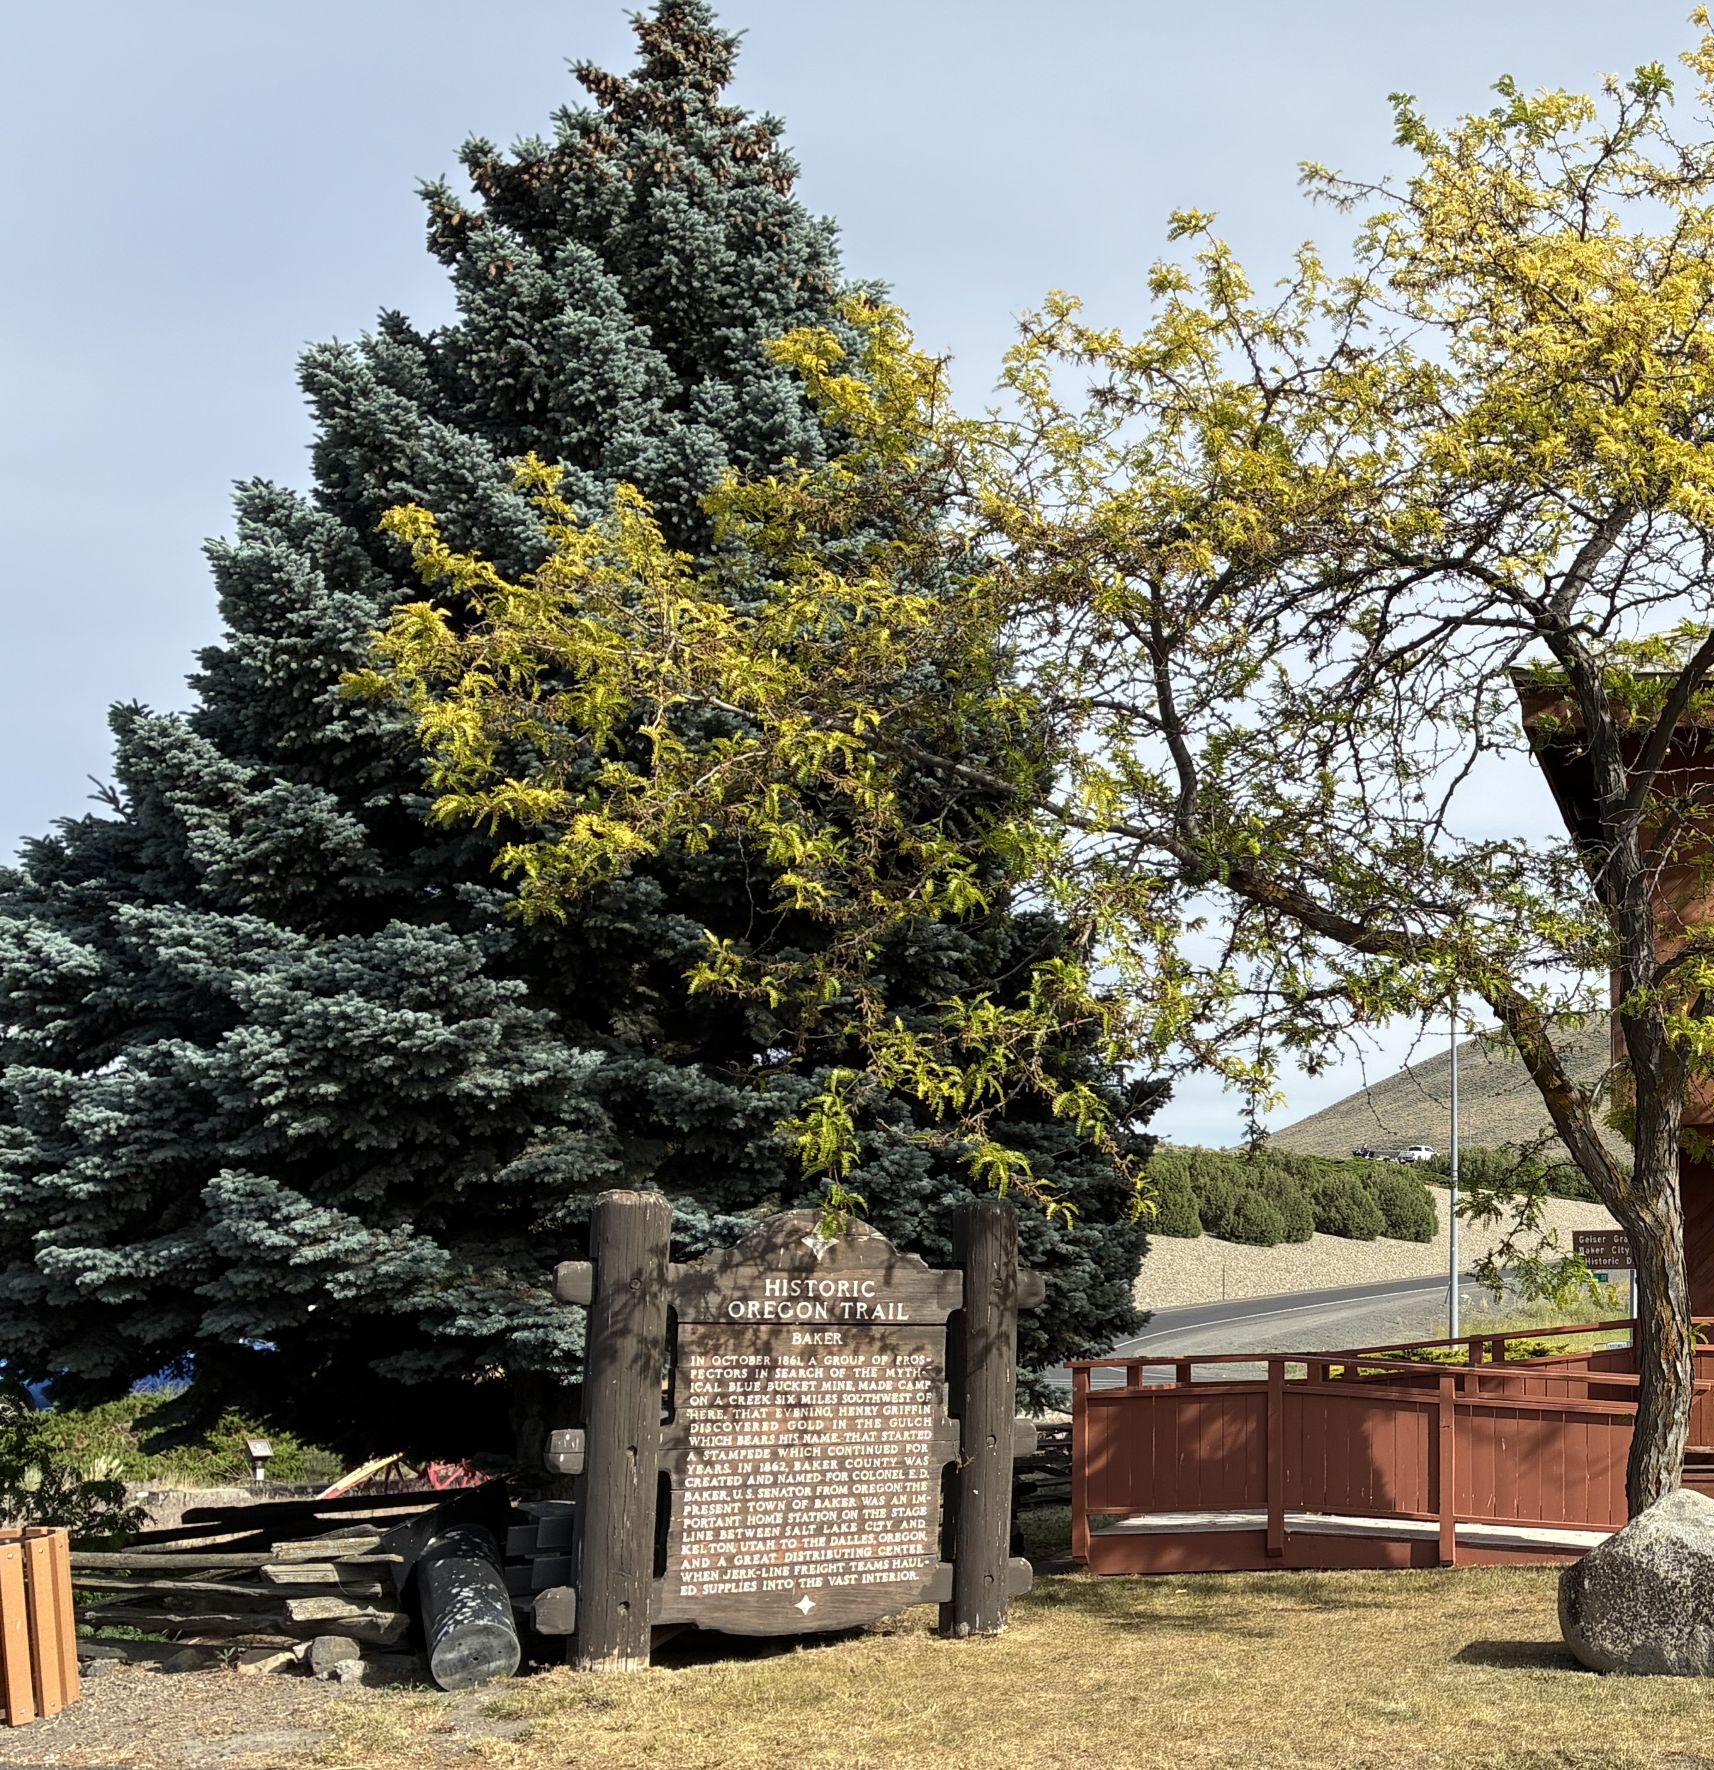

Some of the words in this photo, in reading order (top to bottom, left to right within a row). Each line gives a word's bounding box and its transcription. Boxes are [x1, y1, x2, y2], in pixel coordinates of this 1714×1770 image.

[1579, 1236, 1606, 1244] Geiser
[1613, 1235, 1628, 1243] Gra
[1612, 1246, 1630, 1255] City
[1585, 1257, 1619, 1265] Historic
[764, 1279, 876, 1298] HISTORIC
[728, 1300, 828, 1319] OREGON
[840, 1301, 910, 1320] TRAIL
[791, 1332, 844, 1345] BAKER
[691, 1356, 704, 1366] IN
[712, 1356, 770, 1365] OCTOBER
[808, 1357, 816, 1366] A
[824, 1356, 864, 1365] GROUP
[872, 1356, 888, 1365] OF
[896, 1356, 931, 1365] PROS-
[690, 1369, 748, 1379] PECTORS
[755, 1369, 768, 1379] IN
[775, 1369, 823, 1378] SEARCH
[830, 1369, 845, 1378] OF
[853, 1368, 878, 1377] THE
[886, 1368, 926, 1377] MYTH-
[690, 1382, 721, 1392] ICAL
[728, 1382, 760, 1391] BLUE
[767, 1381, 817, 1391] BUCKET
[858, 1381, 893, 1390] MADE
[898, 1381, 931, 1390] CAMP
[690, 1396, 708, 1406] ON
[714, 1396, 722, 1405] A
[729, 1395, 771, 1405] CREEK
[775, 1395, 795, 1404] SIX
[800, 1394, 837, 1404] MILES
[842, 1394, 912, 1404] SOUTHWEST
[917, 1393, 932, 1402] OF
[733, 1409, 769, 1419] THAT
[839, 1407, 879, 1416] HENRY
[883, 1405, 931, 1415] GRIFFIN
[690, 1422, 779, 1433] DISCOVERED
[788, 1420, 824, 1430] GOLD
[832, 1420, 847, 1429] IN
[857, 1419, 881, 1429] THE
[889, 1417, 932, 1428] GULCH
[689, 1436, 731, 1446] WHICH
[737, 1435, 775, 1445] BEARS
[778, 1434, 798, 1444] HIS
[843, 1432, 877, 1442] THAT
[881, 1430, 932, 1441] STARTED
[687, 1451, 696, 1461] A
[703, 1449, 770, 1460] STAMPEDE
[778, 1448, 820, 1458] WHICH
[828, 1446, 898, 1456] CONTINUED
[906, 1444, 928, 1453] FOR
[737, 1463, 752, 1473] IN
[794, 1461, 838, 1471] BAKER
[845, 1458, 896, 1468] COUNTY
[905, 1456, 929, 1466] WAS
[685, 1476, 742, 1487] CREATED
[747, 1475, 773, 1485] AND
[778, 1473, 821, 1484] NAMED
[826, 1472, 848, 1482] FOR
[853, 1470, 905, 1481] COLONEL
[757, 1487, 812, 1498] SENATOR
[816, 1485, 848, 1495] FROM
[905, 1481, 927, 1491] THE
[683, 1503, 741, 1516] PRESENT
[747, 1501, 786, 1512] TOWN
[792, 1500, 808, 1510] OF
[814, 1499, 856, 1509] BAKER
[861, 1496, 885, 1506] WAS
[890, 1494, 907, 1505] AN
[912, 1494, 931, 1504] IM-
[683, 1517, 741, 1529] PORTANT
[747, 1514, 783, 1525] HOME
[788, 1512, 837, 1523] STATION
[841, 1510, 858, 1520] ON
[863, 1509, 887, 1519] THE
[891, 1507, 927, 1517] STAGE
[683, 1532, 713, 1542] LINE
[720, 1528, 780, 1539] BETWEEN
[785, 1526, 816, 1536] SALT
[823, 1523, 857, 1534] LAKE
[864, 1521, 892, 1532] CITY
[900, 1519, 926, 1529] AND
[740, 1540, 775, 1551] UTAH
[780, 1539, 798, 1549] TO
[802, 1537, 826, 1547] THE
[681, 1558, 710, 1570] AND
[717, 1557, 727, 1567] A
[734, 1554, 778, 1565] GREAT
[784, 1547, 872, 1563] DISTRIBUTING
[878, 1544, 924, 1556] CENTER
[681, 1570, 719, 1582] WHEN
[722, 1566, 790, 1580] JERK-LINE
[794, 1563, 845, 1575] FREIGHT
[848, 1560, 889, 1571] TEAMS
[893, 1557, 929, 1568] HAUL-
[681, 1585, 697, 1596] ED
[703, 1581, 757, 1594] SUPPLIES
[763, 1578, 794, 1590] INTO
[799, 1577, 822, 1588] THE
[828, 1575, 858, 1586] VAST
